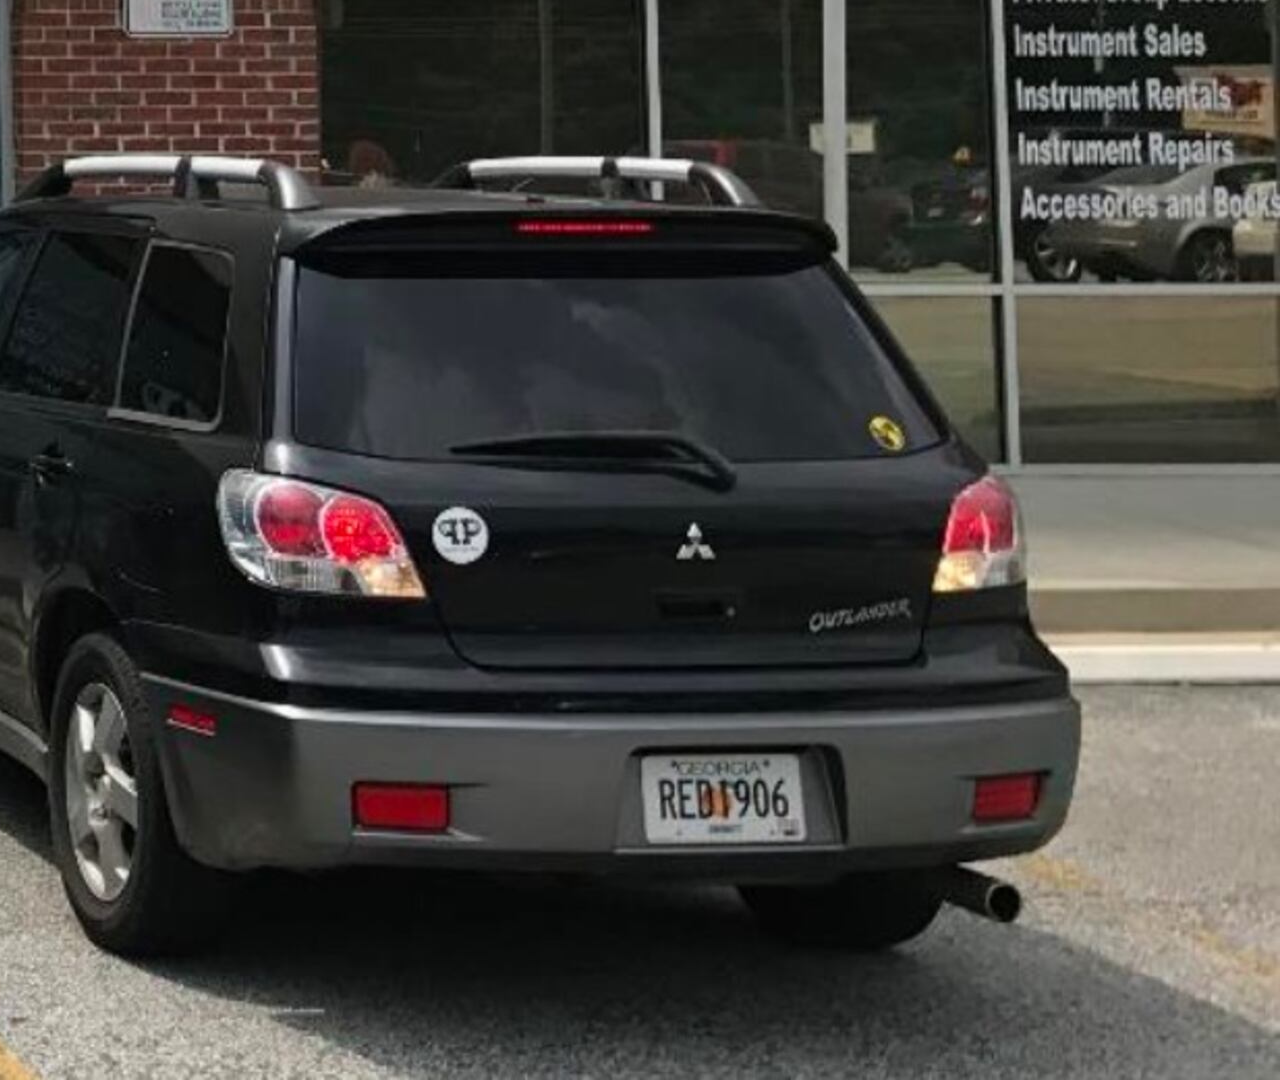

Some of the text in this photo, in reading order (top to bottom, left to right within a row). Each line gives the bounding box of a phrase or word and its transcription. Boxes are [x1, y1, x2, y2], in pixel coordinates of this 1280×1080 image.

[1014, 23, 1208, 58] Instrument Sales
[1015, 77, 1232, 111] Instrument Rentals
[1017, 132, 1235, 174] Instrument Repairs
[1020, 185, 1280, 220] Accessories and Books
